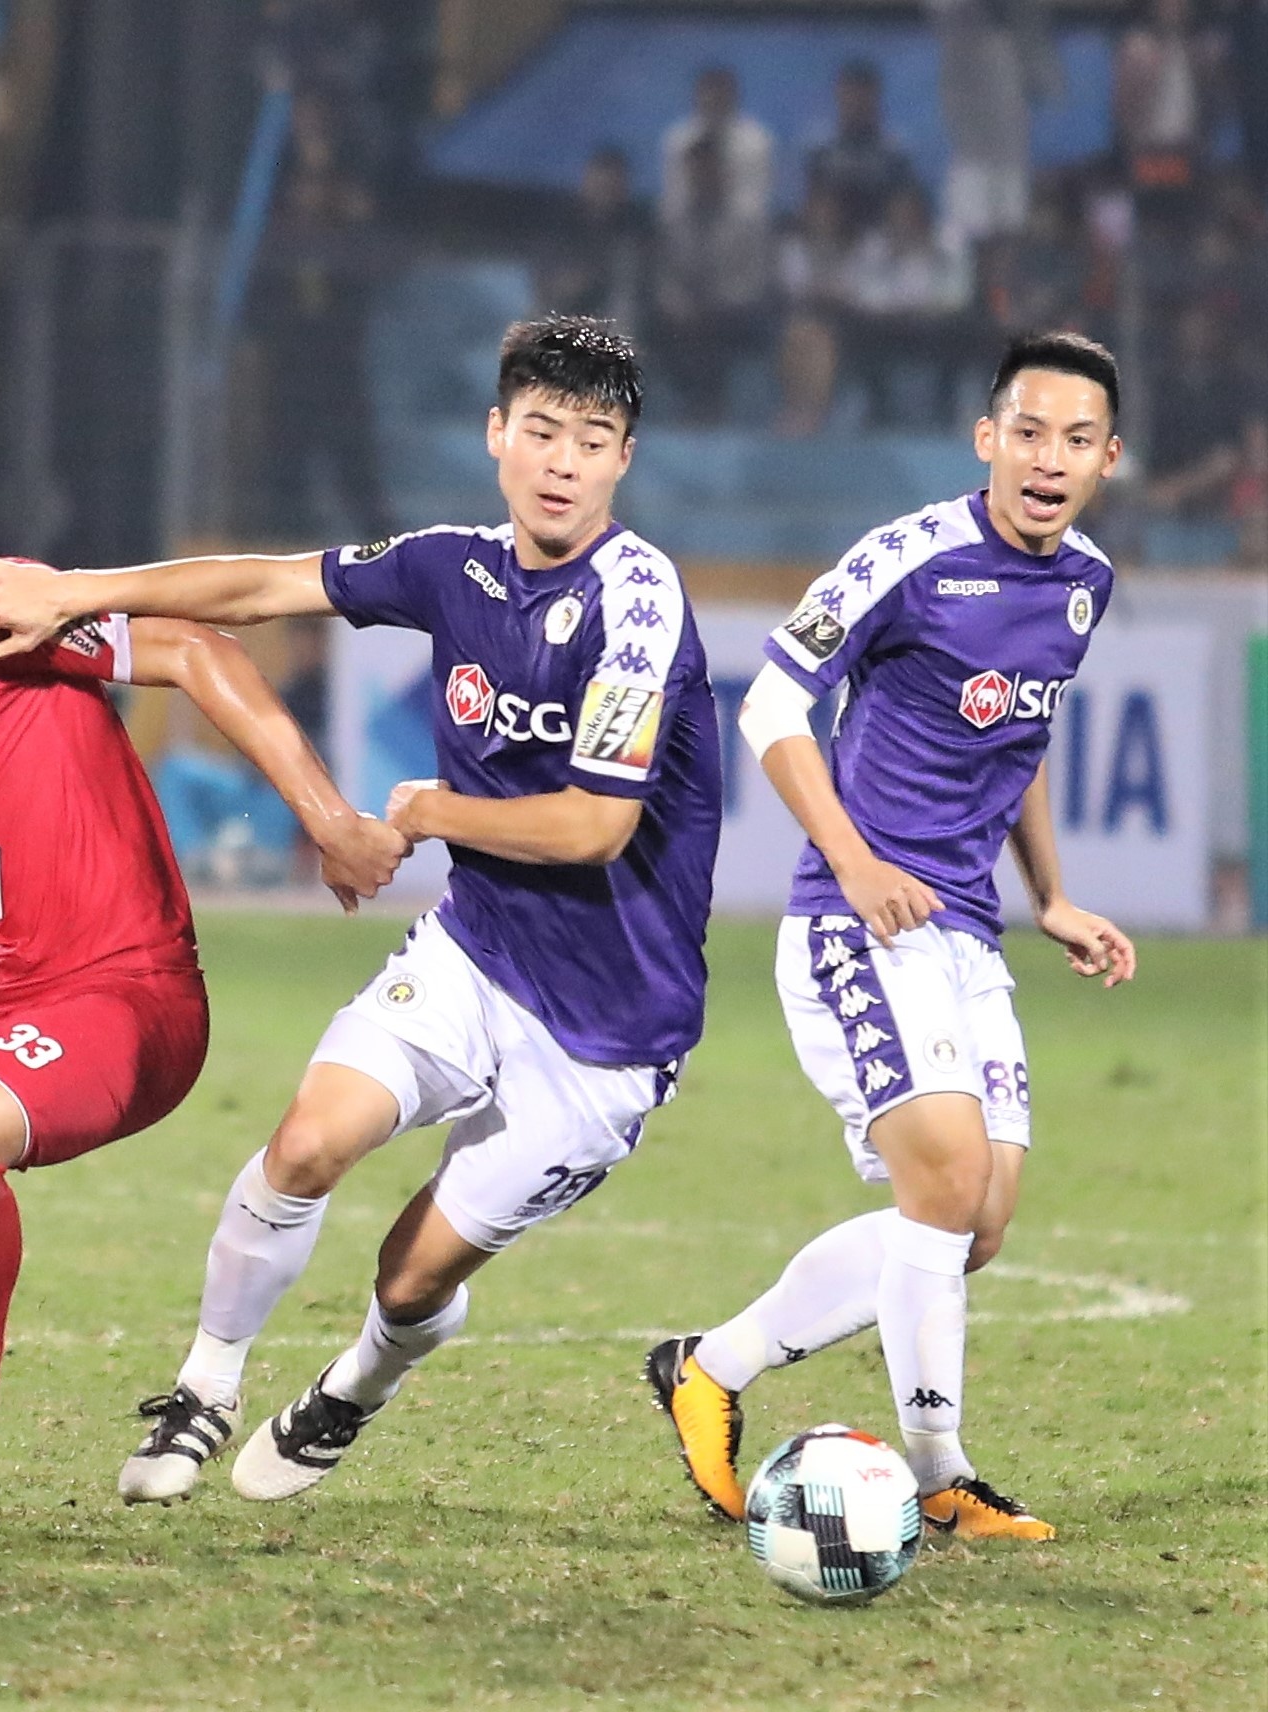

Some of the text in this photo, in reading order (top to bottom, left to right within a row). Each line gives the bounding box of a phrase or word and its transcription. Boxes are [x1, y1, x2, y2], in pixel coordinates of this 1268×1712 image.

[939, 581, 999, 594] Kappa
[494, 693, 573, 742] SCG
[983, 1060, 1030, 1111] 88
